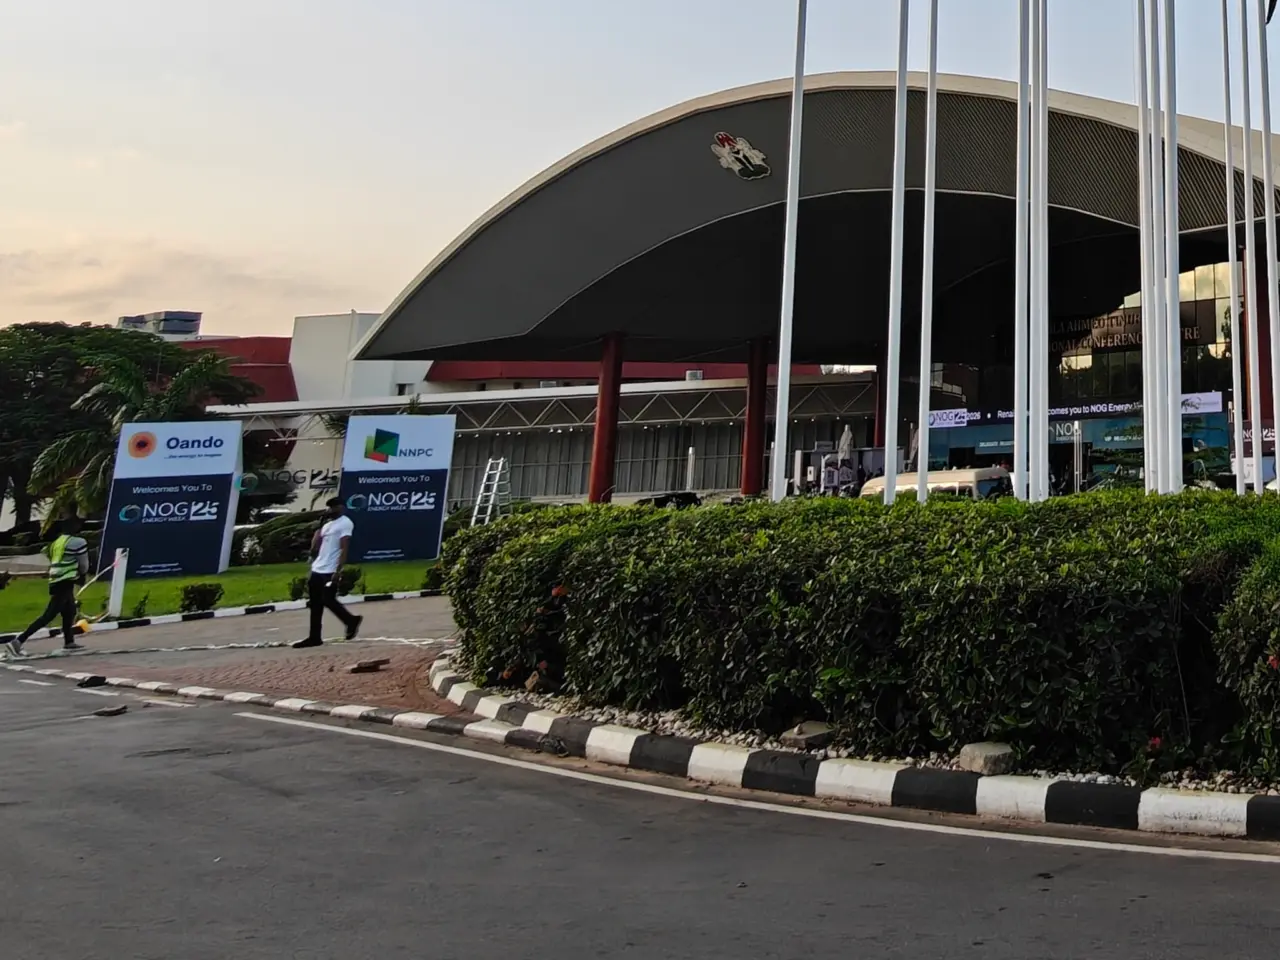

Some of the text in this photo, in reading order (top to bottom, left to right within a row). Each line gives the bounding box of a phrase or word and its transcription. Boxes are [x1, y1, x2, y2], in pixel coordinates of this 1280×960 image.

[1109, 312, 1141, 328] TINUB
[1080, 331, 1142, 349] CONFERENC
[1048, 406, 1068, 416] comes
[1069, 407, 1081, 416] you
[1083, 405, 1089, 414] to
[1090, 403, 1107, 413] NOG
[166, 436, 224, 450] Oando
[399, 448, 433, 457] NNPC
[358, 474, 431, 484] Welcomes You To
[132, 483, 213, 494] Welcomes You To
[367, 491, 437, 510] NOG 25
[142, 500, 220, 521] NOG 25
